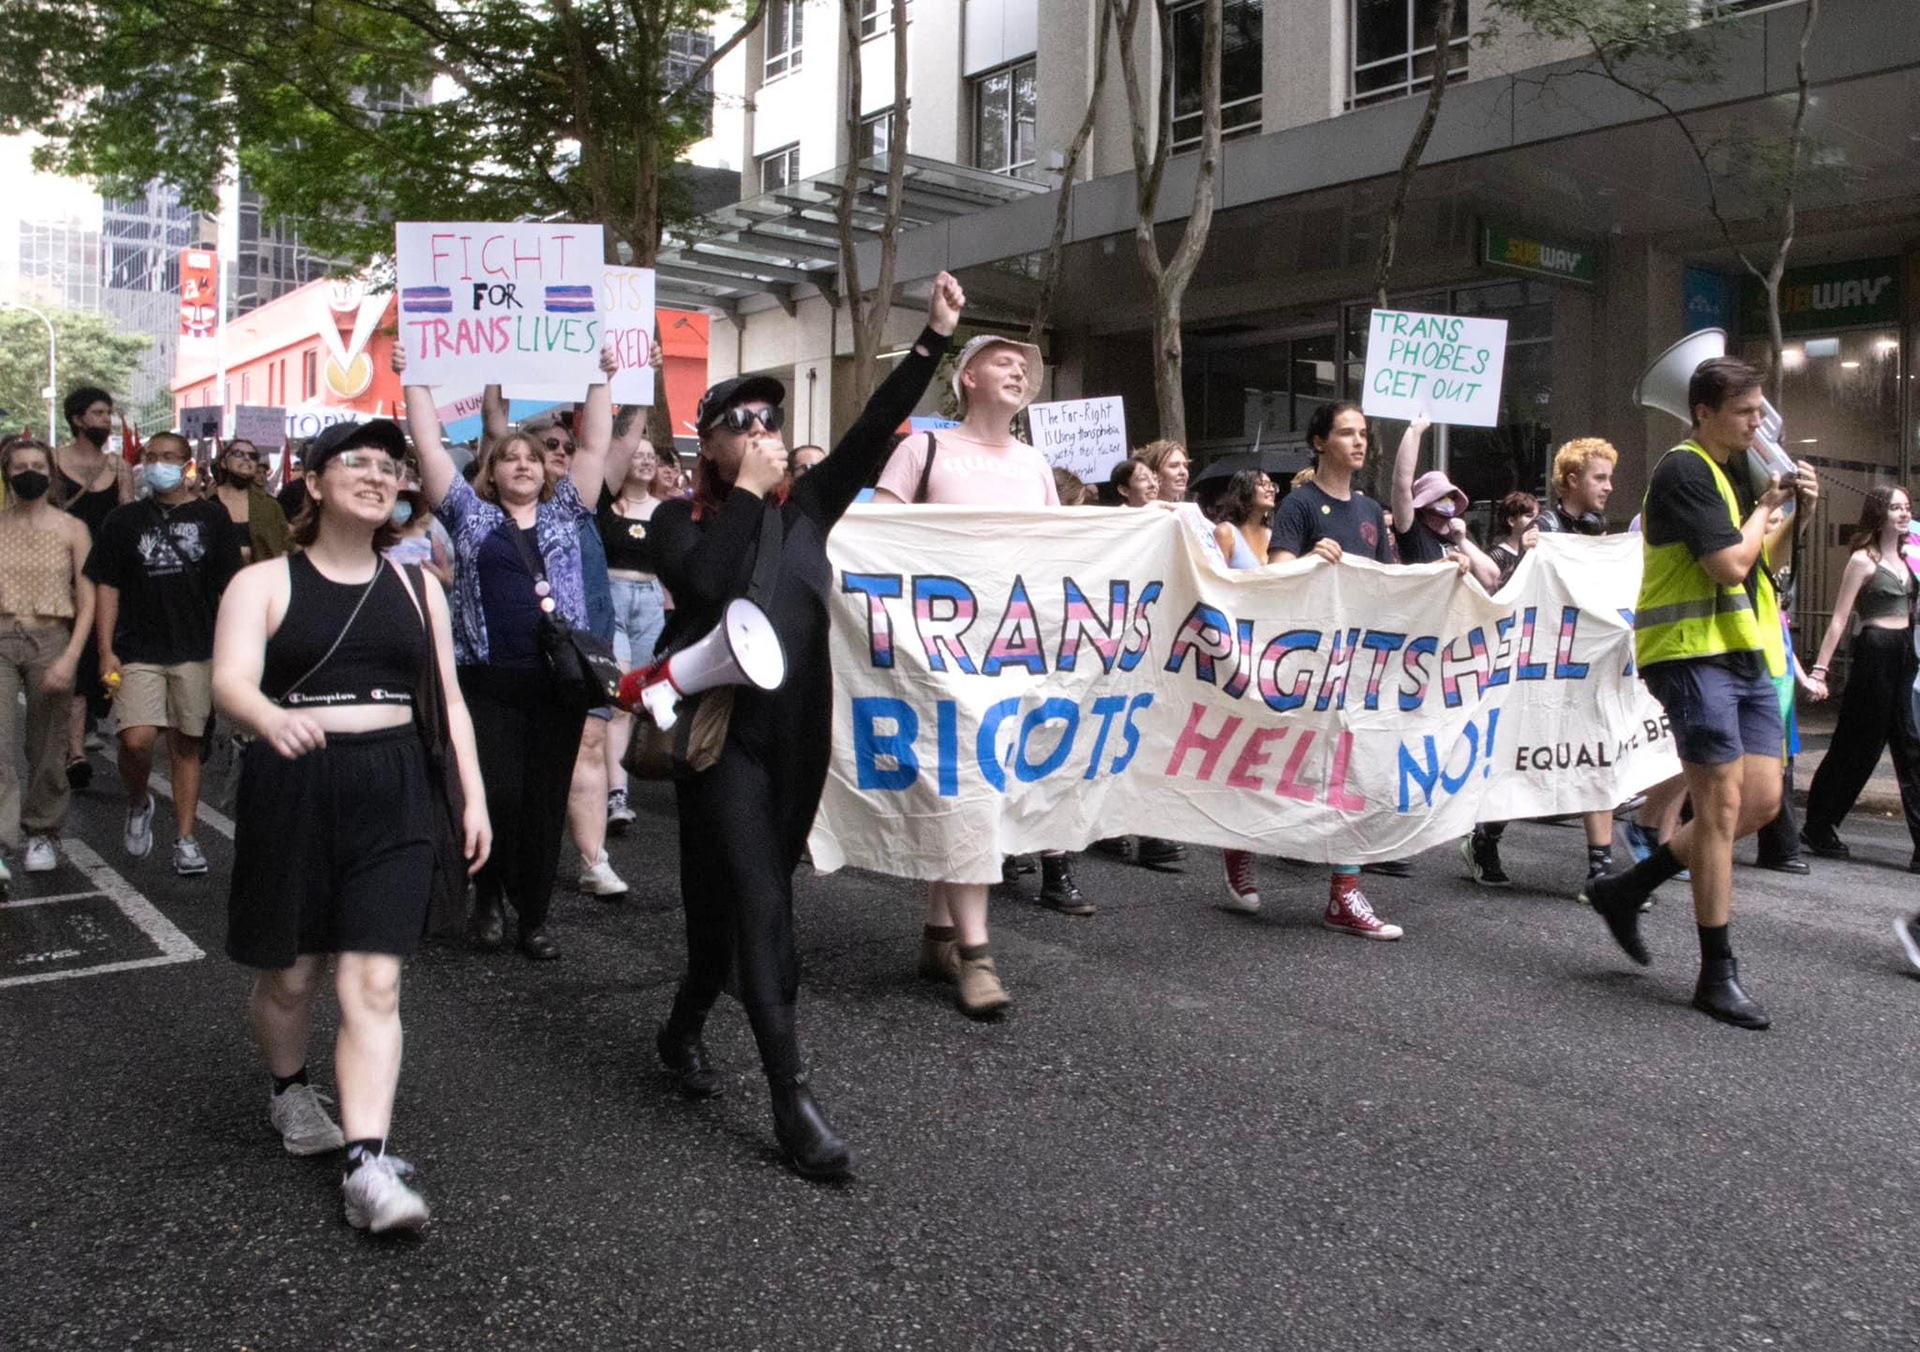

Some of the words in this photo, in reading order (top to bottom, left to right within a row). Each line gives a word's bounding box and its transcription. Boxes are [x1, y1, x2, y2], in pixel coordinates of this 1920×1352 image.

[431, 233, 575, 282] FIGHT
[472, 283, 523, 310] FOR
[603, 271, 642, 312] STS
[407, 315, 512, 359] TRANS
[515, 315, 600, 353] LIVES
[1373, 312, 1464, 343] TRANS
[605, 328, 650, 369] KED
[1388, 338, 1490, 375] PHOBES
[1373, 368, 1427, 399] GET
[1432, 378, 1481, 403] OUT
[1033, 407, 1059, 426] The
[841, 571, 1163, 676] TRANS
[1164, 601, 1439, 713] RIGHTS
[1441, 606, 1591, 708] HELL
[288, 692, 357, 704] Champion
[851, 692, 1155, 796] BIGOTS
[1164, 703, 1365, 812] HELL
[1397, 708, 1500, 813] NO!
